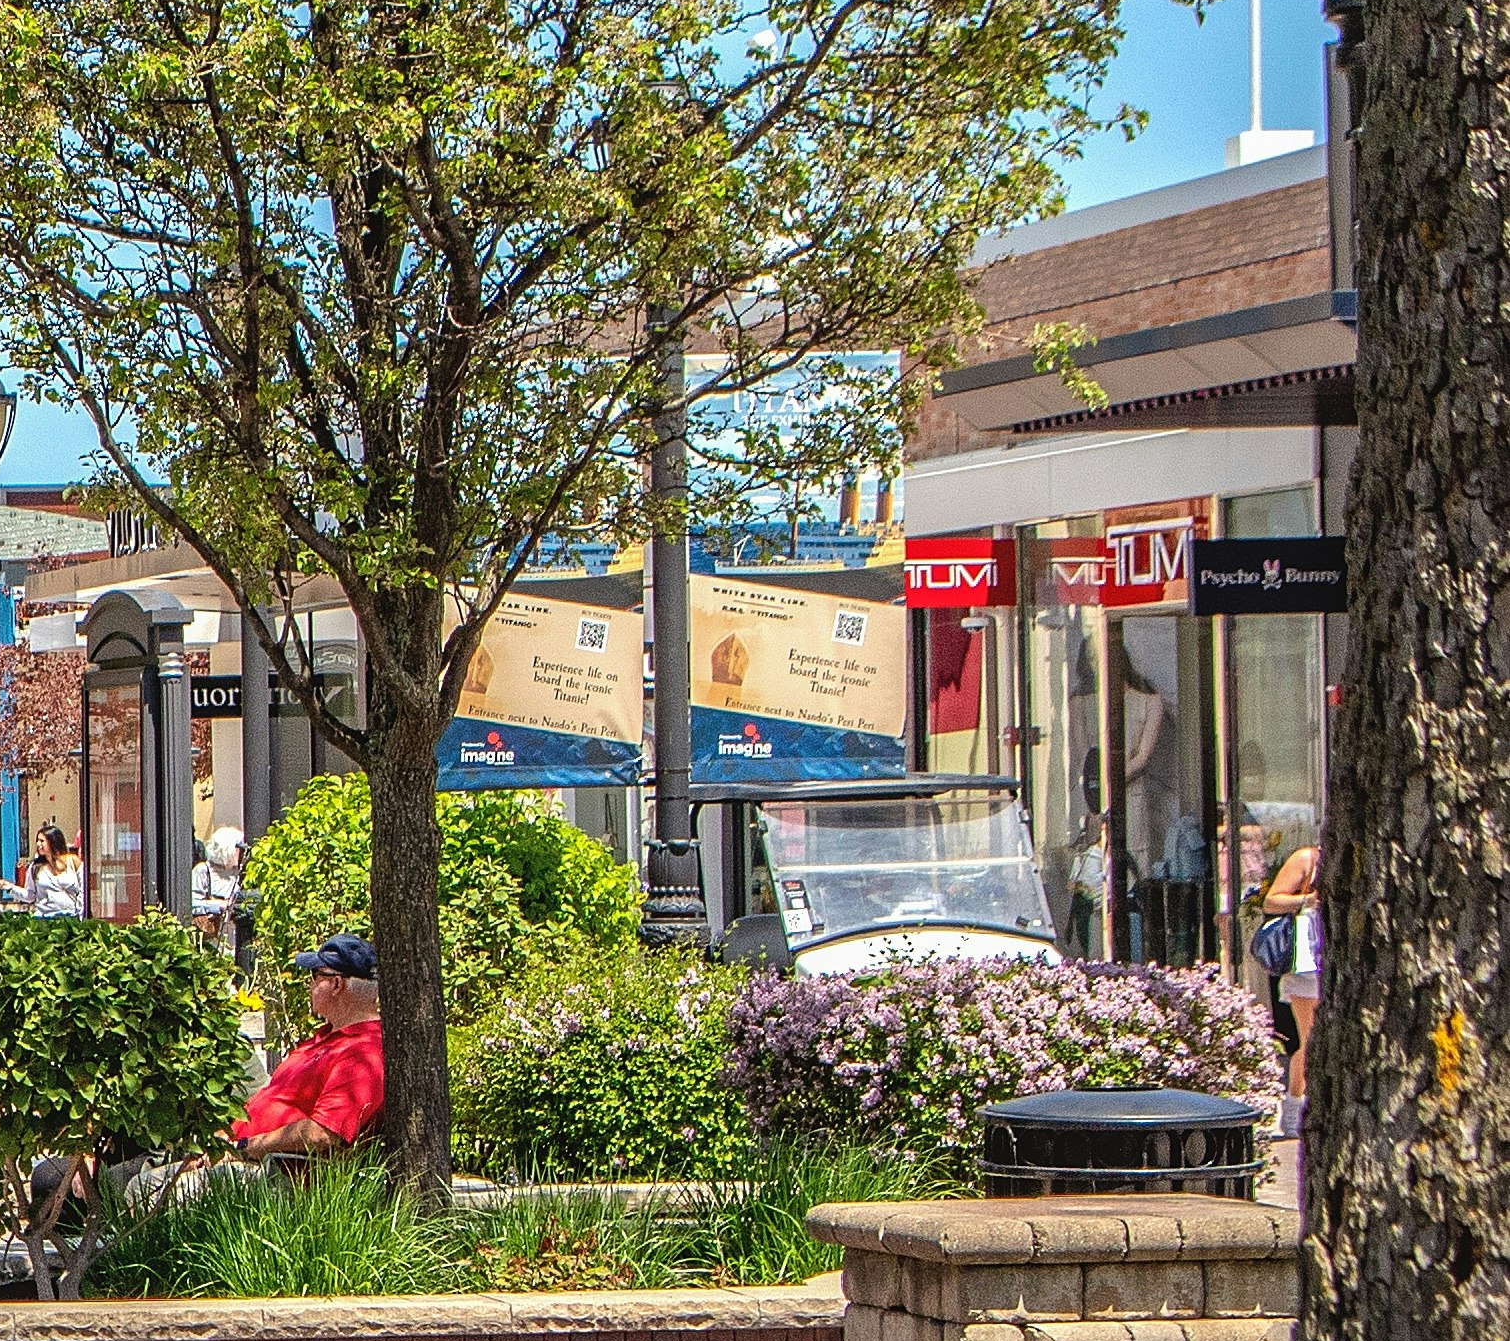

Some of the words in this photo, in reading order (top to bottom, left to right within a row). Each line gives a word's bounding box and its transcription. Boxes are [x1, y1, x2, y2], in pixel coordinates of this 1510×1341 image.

[904, 558, 997, 588] TUMI
[1200, 568, 1260, 588] Psycho
[1285, 567, 1341, 585] Bunny
[500, 602, 522, 611] TAR
[533, 655, 584, 676] Experience
[588, 665, 602, 680] life
[606, 673, 618, 682] on
[789, 648, 839, 669] Experience
[844, 659, 859, 672] life
[864, 665, 876, 675] on
[533, 671, 561, 687] board
[566, 677, 580, 689] the
[584, 680, 612, 695] iconic
[789, 664, 817, 679] board
[822, 670, 837, 682] the
[841, 672, 870, 687] iconic
[192, 687, 240, 707] uor
[554, 688, 589, 705] Titanic!
[810, 680, 846, 698] Titanic!
[468, 704, 505, 721] Entrance
[508, 713, 525, 724] next
[529, 716, 537, 725] to
[542, 716, 576, 731] Nando's
[580, 722, 597, 735] Peri
[600, 726, 618, 738] Peri
[725, 697, 761, 712] Entrance
[764, 705, 782, 716] next
[785, 708, 794, 717] to
[797, 708, 834, 724] Nando's
[837, 715, 854, 727] Peri
[857, 718, 875, 730] Peri
